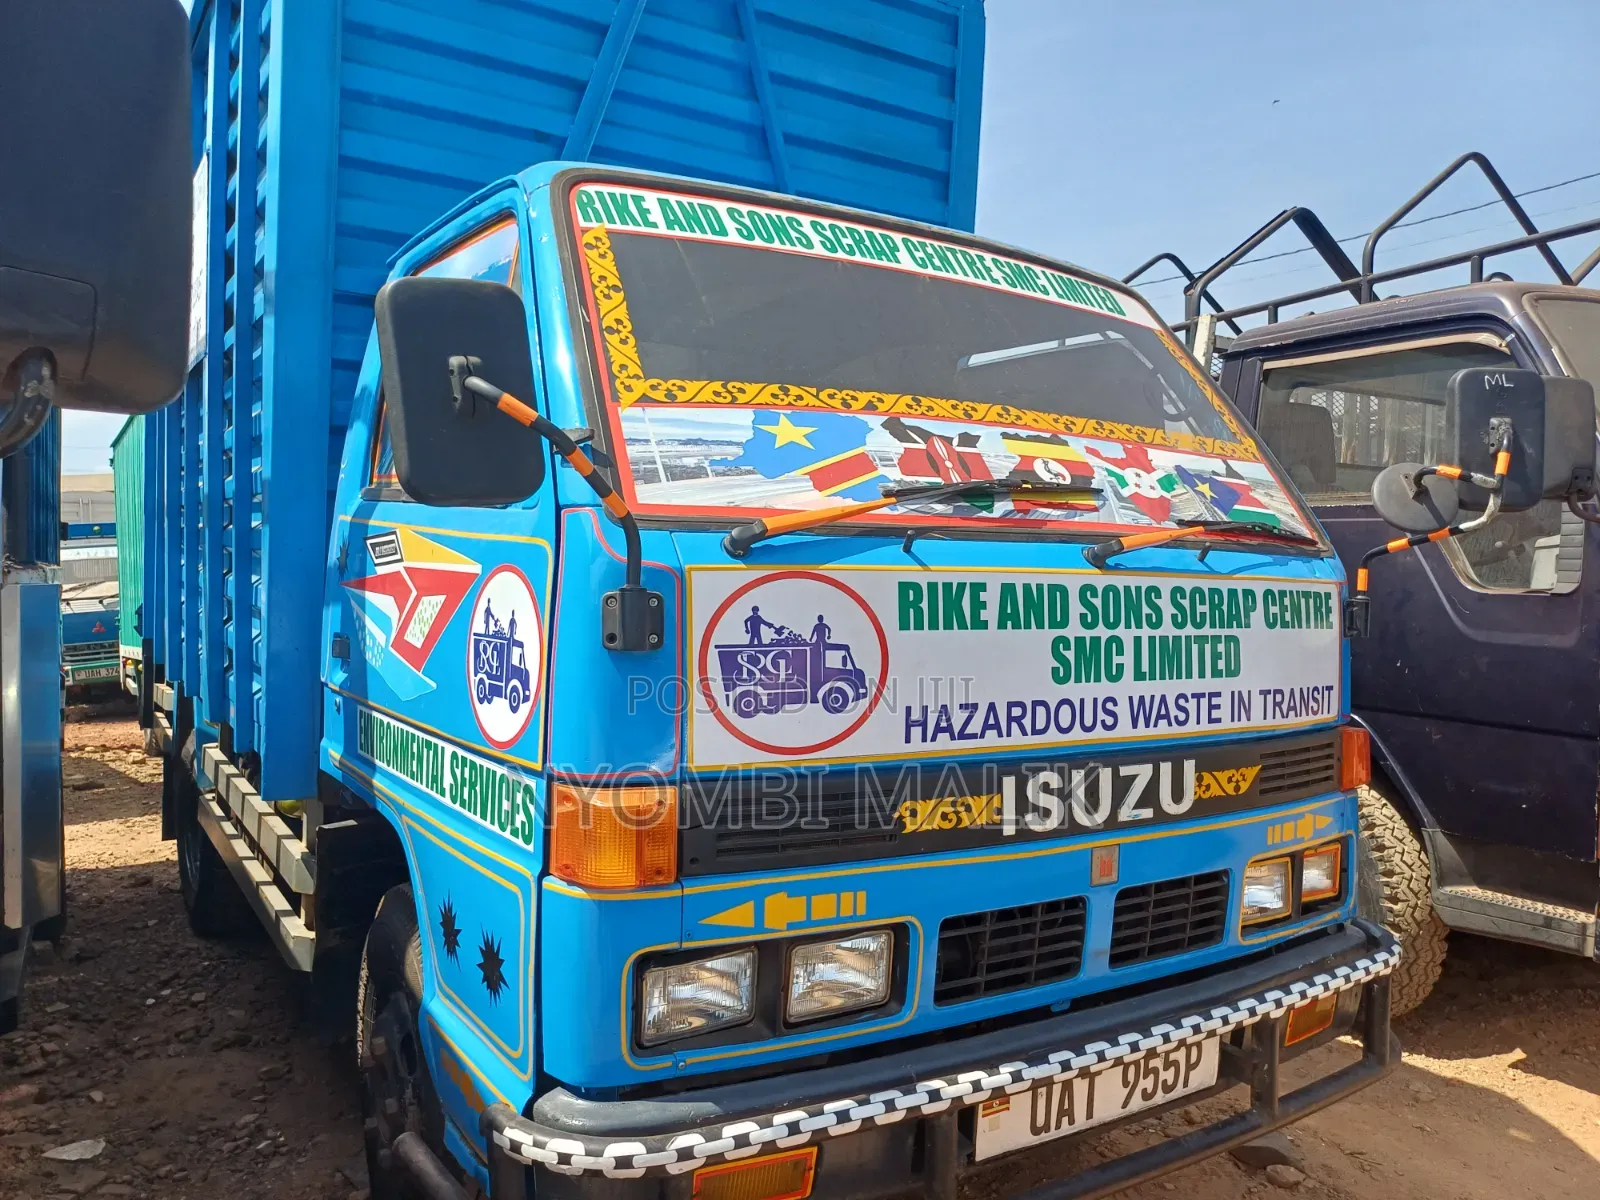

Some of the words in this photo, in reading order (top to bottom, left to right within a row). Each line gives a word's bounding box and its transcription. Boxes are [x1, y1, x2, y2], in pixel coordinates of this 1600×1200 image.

[576, 189, 659, 229] RIKE
[657, 197, 729, 238] AND
[727, 207, 815, 250] SONS
[811, 220, 901, 265] SCRAP
[901, 237, 1000, 286] CENTRE
[991, 257, 1050, 296] SMC
[1041, 270, 1126, 317] LIMITED
[1484, 373, 1514, 390] ML
[897, 581, 989, 631] RIKE
[998, 582, 1071, 631] AND
[1078, 583, 1164, 631] SONS
[1170, 585, 1258, 631] SCRAP
[1262, 588, 1334, 631] CENTRE
[85, 668, 101, 677] UAH
[1050, 634, 1125, 686] SMC
[1133, 634, 1242, 682] LIMITED
[903, 696, 1119, 745] HAZARDOUS
[1128, 691, 1223, 731] WASTE
[1229, 689, 1253, 722] IN
[1259, 685, 1335, 720] TRANSIT
[359, 709, 446, 799] ENVIRONMENTAL
[449, 750, 535, 848] SERVICES
[1001, 758, 1198, 837] ISUZU
[1029, 1072, 1103, 1137] UAT
[1121, 1041, 1203, 1110] 955P
